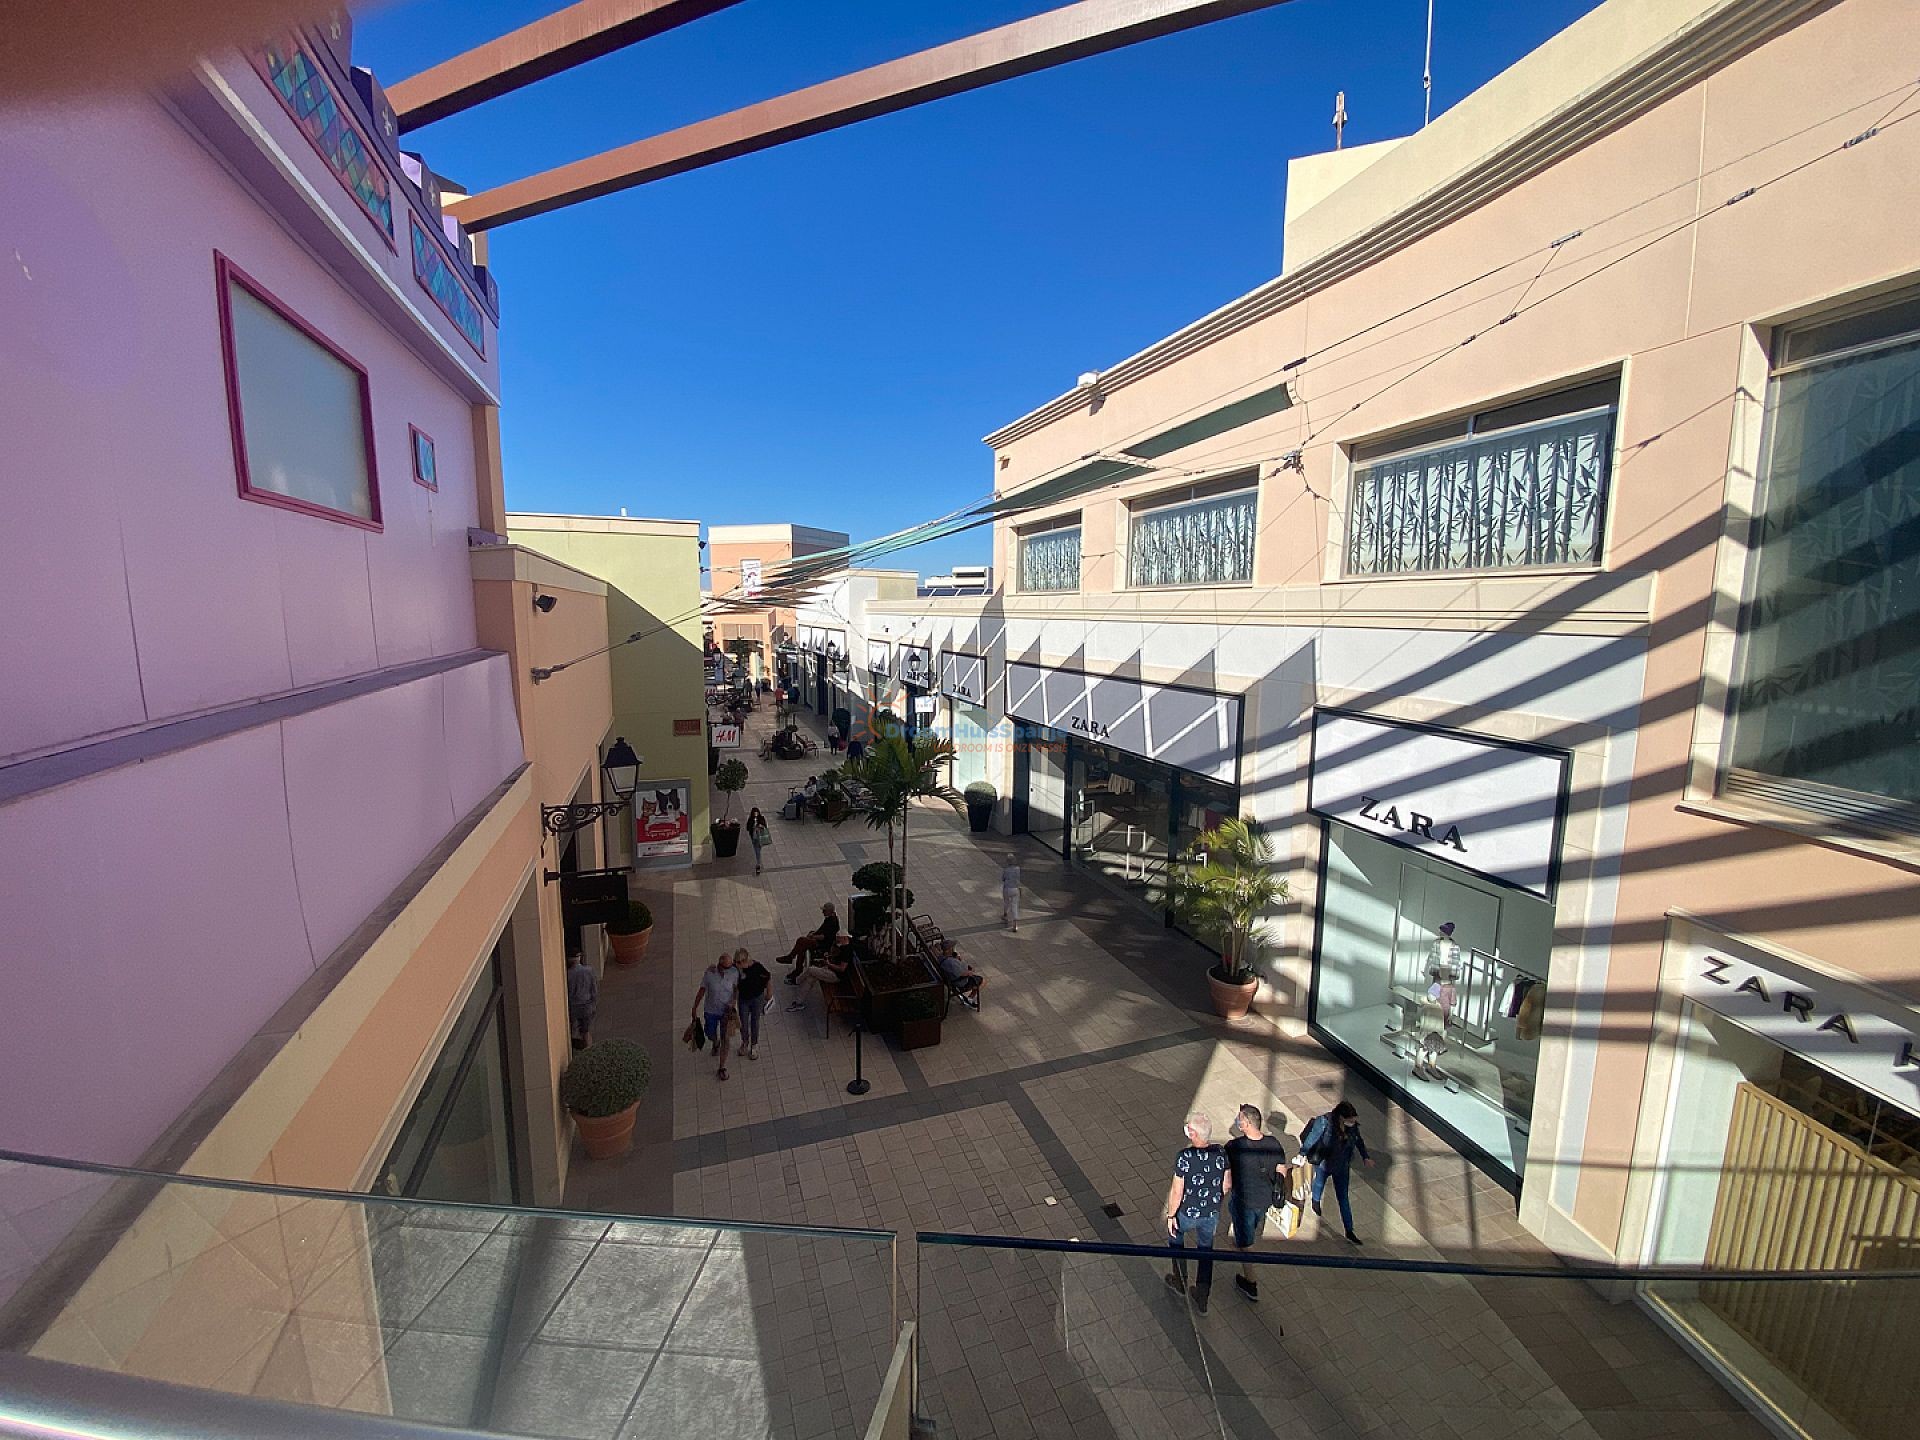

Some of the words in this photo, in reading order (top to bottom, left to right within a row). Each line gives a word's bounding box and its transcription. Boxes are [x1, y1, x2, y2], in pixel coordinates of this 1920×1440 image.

[1072, 715, 1110, 738] ZARA
[1359, 795, 1468, 853] ZARA
[1700, 955, 1859, 1044] ZARA
